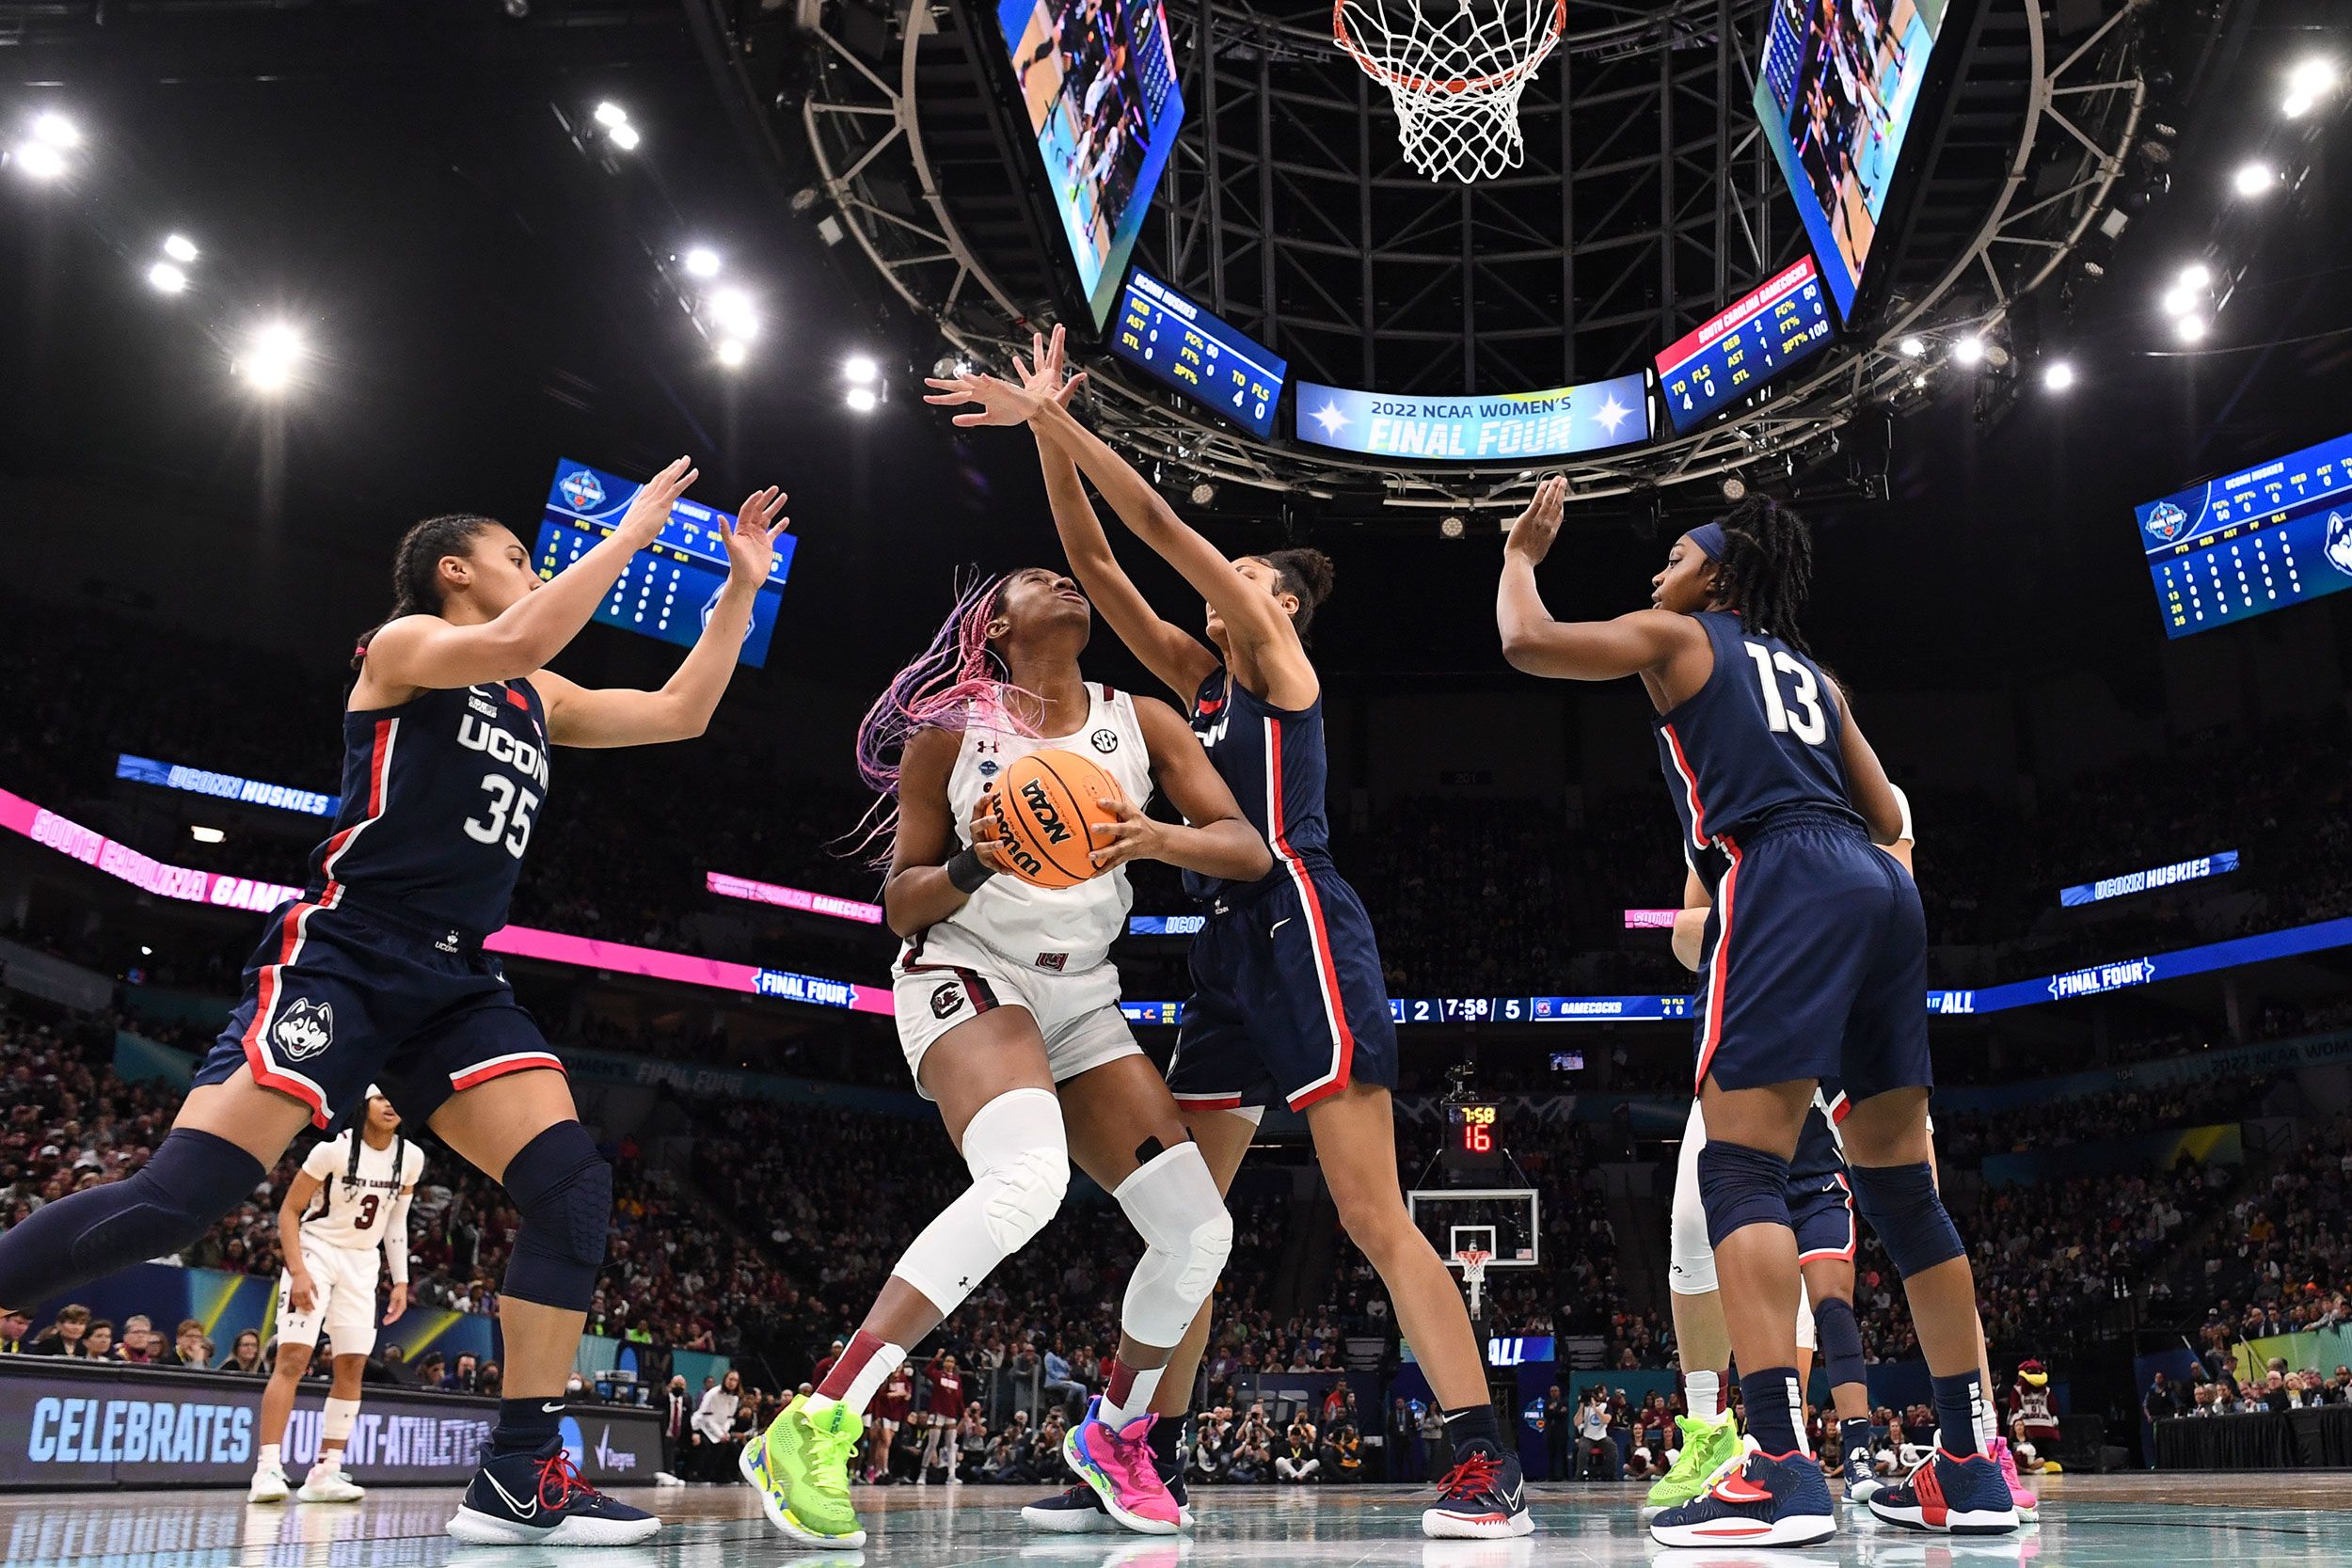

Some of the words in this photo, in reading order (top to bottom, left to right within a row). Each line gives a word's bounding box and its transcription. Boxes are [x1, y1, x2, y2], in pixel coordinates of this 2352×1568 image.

[1155, 312, 1163, 325] 1
[1774, 299, 1796, 319] FG%
[1779, 315, 1800, 334] FT%
[1813, 302, 1822, 315] 0
[1126, 314, 1146, 331] AST
[1150, 329, 1158, 342] 0
[1722, 334, 1741, 353] REB
[1754, 319, 1763, 333] 2
[1781, 331, 1808, 355] 3PT%
[1808, 319, 1829, 341] 100
[1122, 332, 1139, 351] STL
[1145, 347, 1153, 360] 0
[1181, 346, 1200, 366] FT%
[1206, 364, 1215, 377] 0
[1726, 349, 1744, 368] AST
[1759, 336, 1768, 349] 1
[1173, 362, 1199, 386] 3PT%
[1232, 369, 1247, 388] TO
[1251, 383, 1270, 402] FLS
[1671, 380, 1686, 396] TO
[1692, 364, 1711, 384] FLS
[1732, 368, 1750, 386] STL
[1764, 354, 1772, 367] 1
[1232, 389, 1244, 407] 4
[1254, 403, 1265, 420] 0
[1371, 400, 1417, 418] 2022
[1422, 404, 1473, 419] NCAA
[1480, 396, 1572, 419] WOMEN'S
[1682, 392, 1693, 410] 4
[1704, 379, 1715, 397] 0
[1367, 417, 1466, 456] FINAL
[1477, 414, 1575, 456] FOUR
[2243, 501, 2251, 513] 0
[2271, 492, 2280, 504] 0
[2297, 483, 2305, 495] 1
[2323, 475, 2332, 487] 0
[1743, 640, 1827, 746] 13
[1092, 730, 1118, 752] SEC
[167, 765, 245, 799] UCONN
[240, 780, 329, 816] HUSKIES
[462, 772, 539, 861] 35
[1021, 777, 1072, 847] NCAA
[2094, 871, 2145, 900] UCONN
[2145, 857, 2211, 889] HUSKIES
[762, 972, 805, 998] FINAL
[806, 980, 848, 1005] FOUR
[2058, 971, 2101, 996] FINAL
[2101, 961, 2144, 988] FOUR
[1414, 1001, 1430, 1021] 2
[1445, 999, 1488, 1016] 7:58
[1504, 1000, 1521, 1020] 5
[1560, 1001, 1623, 1015] GAMECOCKS
[1662, 1006, 1671, 1016] 4
[1676, 1006, 1684, 1016] 0
[1940, 991, 1975, 1014] ALL
[1461, 1107, 1496, 1124] 7:58
[1465, 1124, 1491, 1152] 16
[354, 1194, 380, 1229] 3
[1488, 1338, 1526, 1366] ALL
[27, 1396, 254, 1464] CELEBRATES
